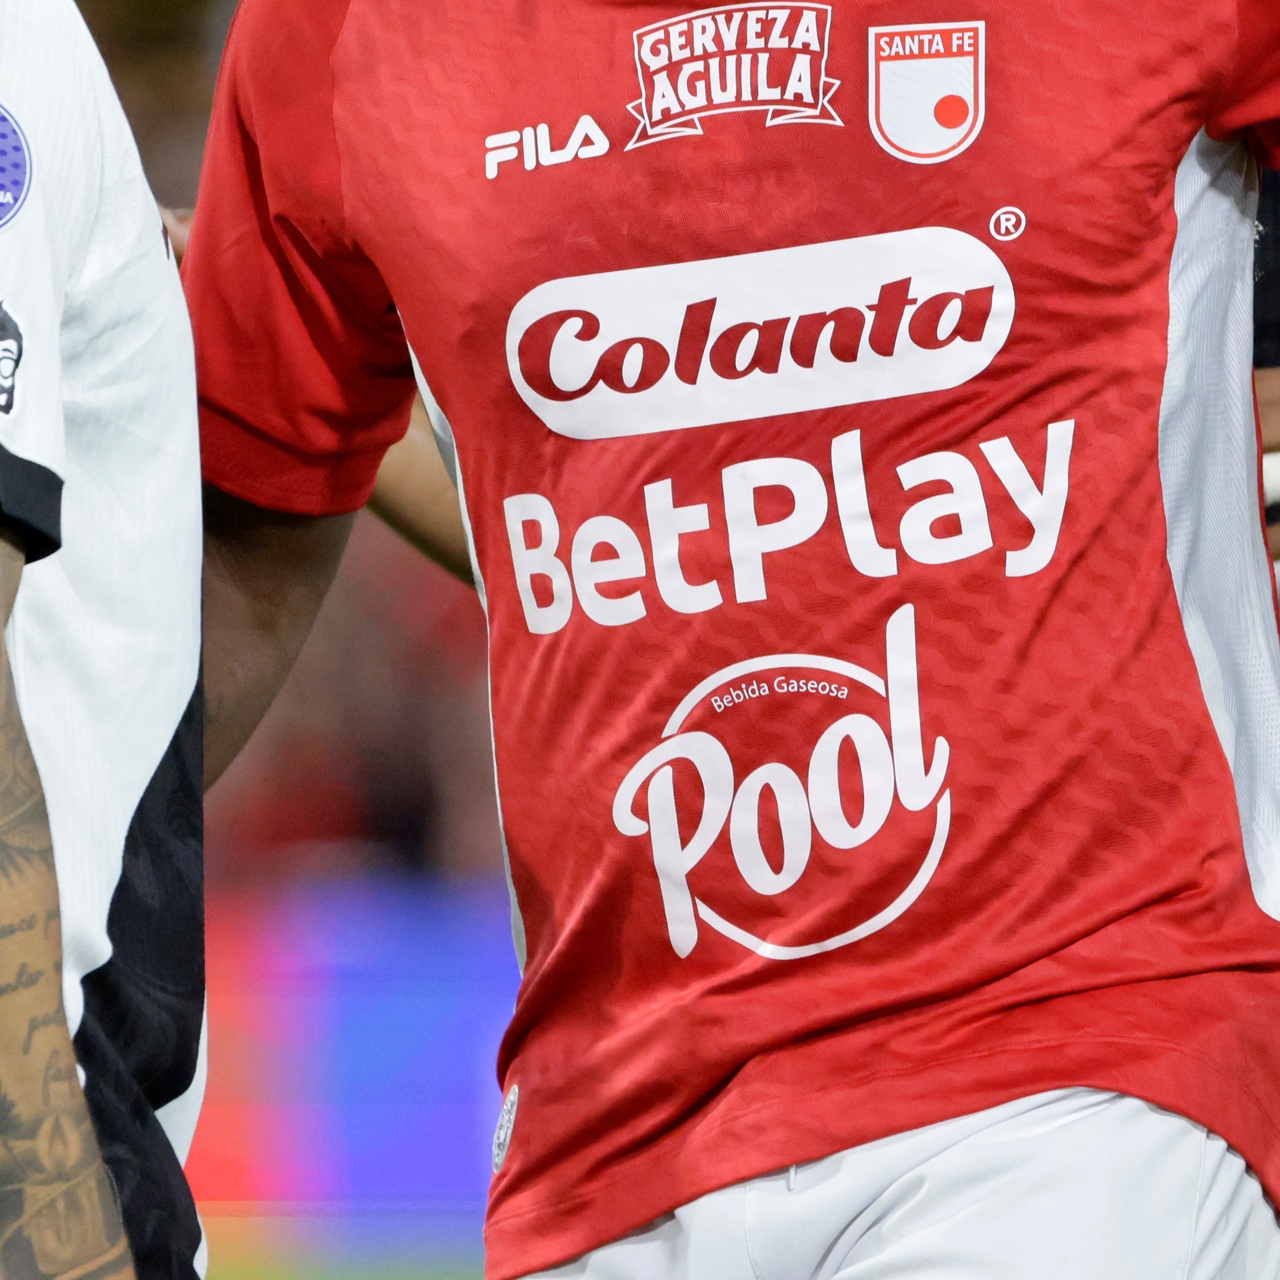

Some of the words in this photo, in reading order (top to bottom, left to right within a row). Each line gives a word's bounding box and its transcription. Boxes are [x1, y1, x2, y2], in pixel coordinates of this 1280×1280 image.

[879, 33, 945, 57] SANTA
[951, 31, 975, 54] FE
[484, 114, 610, 180] FILA
[517, 276, 995, 402] Colanta
[503, 418, 1076, 635] BetPlay
[710, 680, 770, 713] Bebida
[773, 676, 849, 700] Gaseosa
[612, 603, 950, 959] Pool
